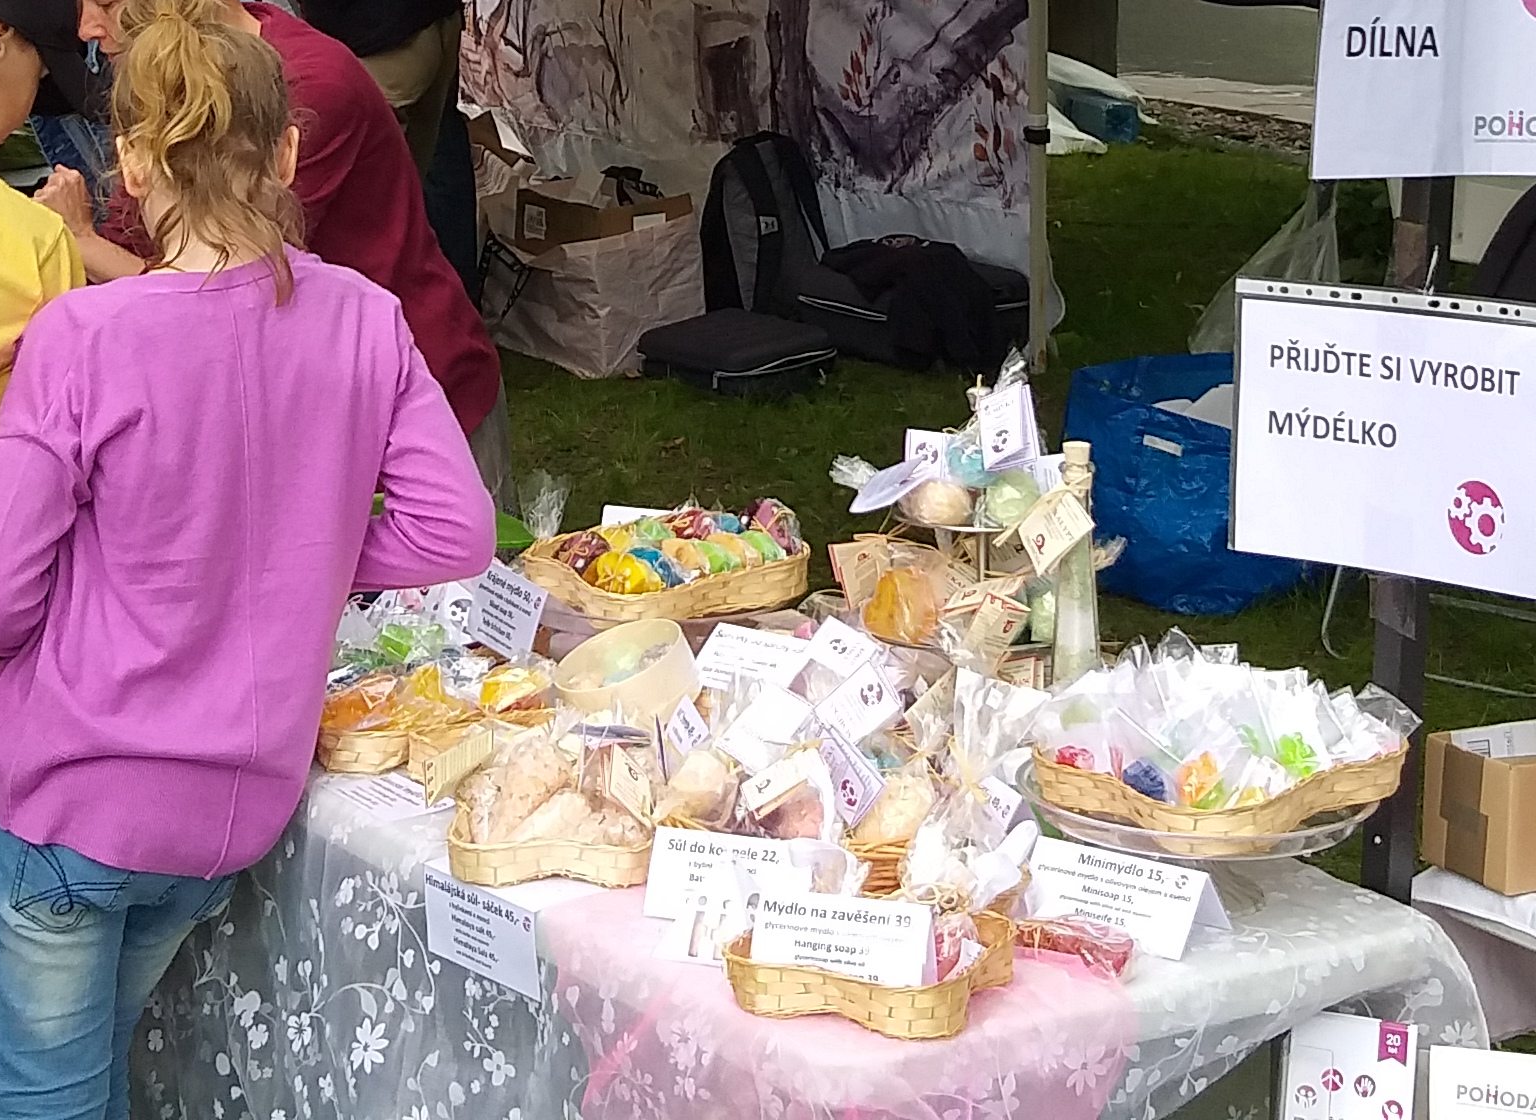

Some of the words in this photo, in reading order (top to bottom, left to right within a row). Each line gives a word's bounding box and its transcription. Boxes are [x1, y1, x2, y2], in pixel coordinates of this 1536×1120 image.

[1345, 16, 1439, 59] DÍLNA
[1269, 338, 1372, 379] PŘIJĎTE
[1380, 355, 1402, 383] SI
[1409, 357, 1521, 397] VYROBIT
[1267, 407, 1398, 449] MÝDÉLKO
[667, 838, 687, 852] Sůl
[689, 841, 706, 854] do
[708, 842, 758, 861] kopele
[425, 873, 466, 902] Himalájská
[482, 900, 504, 918] sáček
[1081, 884, 1120, 901] Minisoap
[810, 907, 828, 919] na
[1074, 907, 1113, 923] Miniseife
[834, 944, 857, 956] soap
[1385, 1033, 1401, 1047] 20
